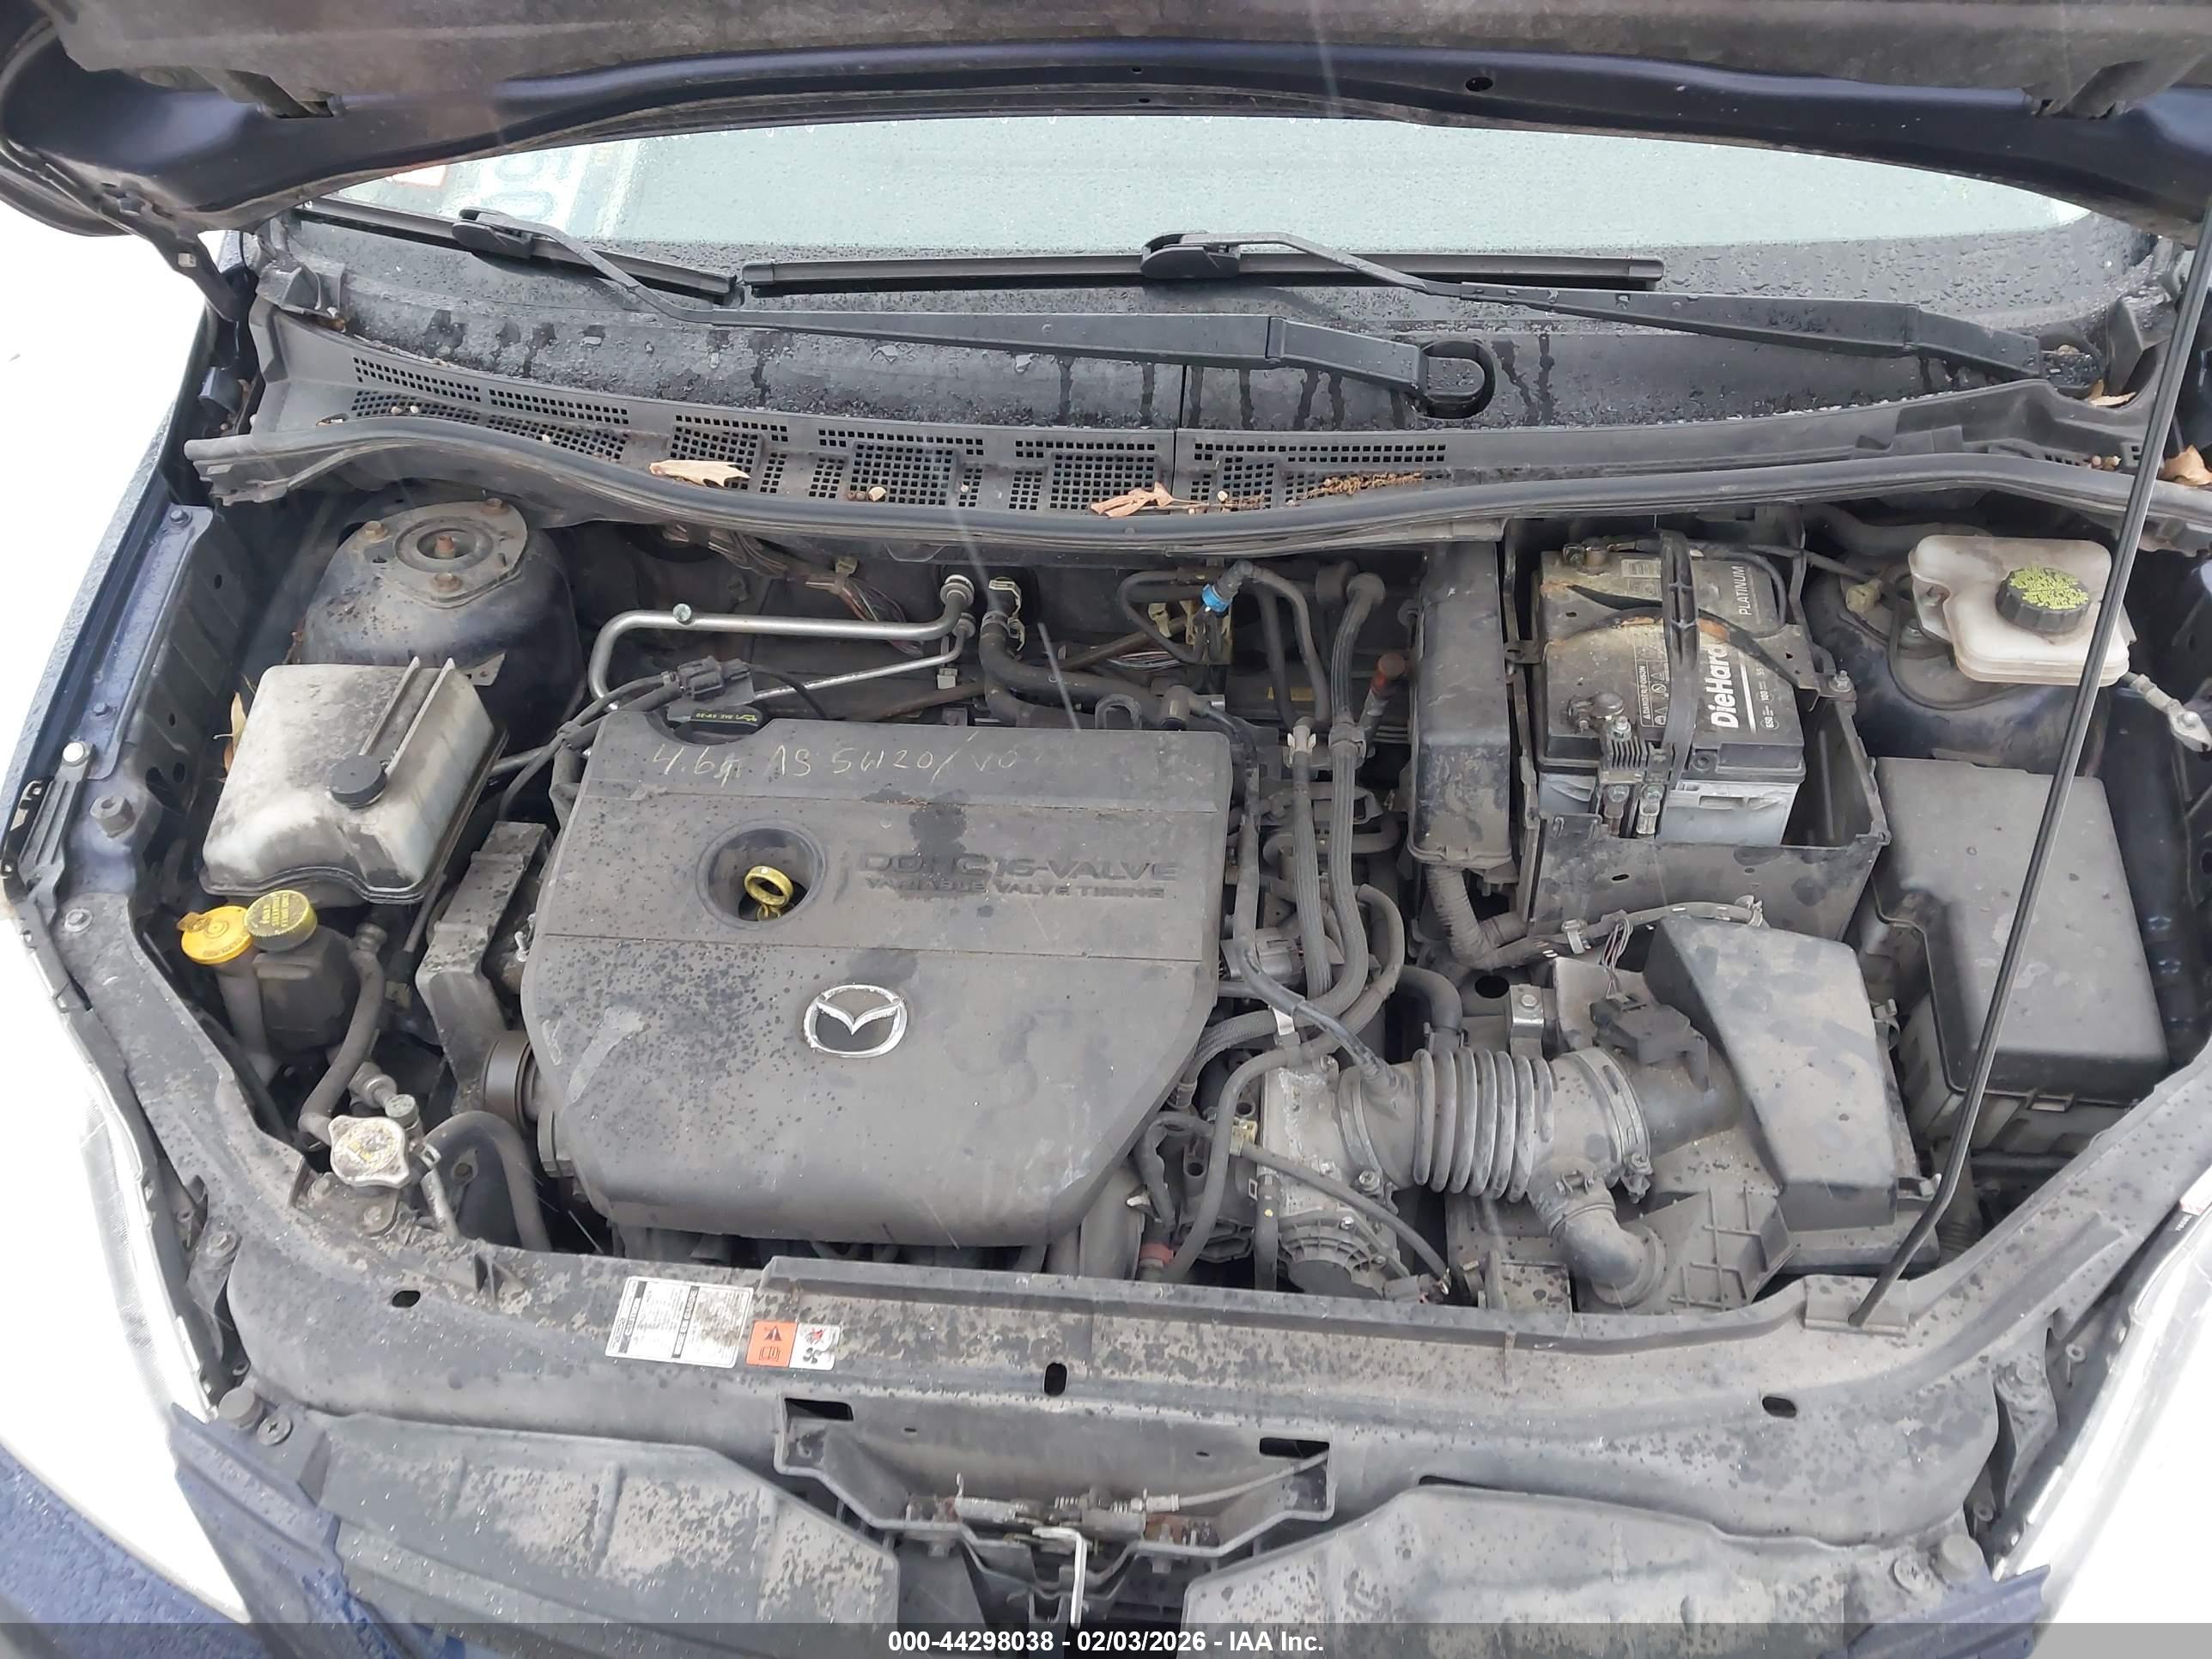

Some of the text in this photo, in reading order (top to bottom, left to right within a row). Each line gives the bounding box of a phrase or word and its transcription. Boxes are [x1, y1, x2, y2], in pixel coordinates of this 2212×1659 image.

[1731, 565, 1751, 616] PLATINUM
[995, 857, 1177, 881] 16-VALVE
[994, 882, 1071, 896] VALVE
